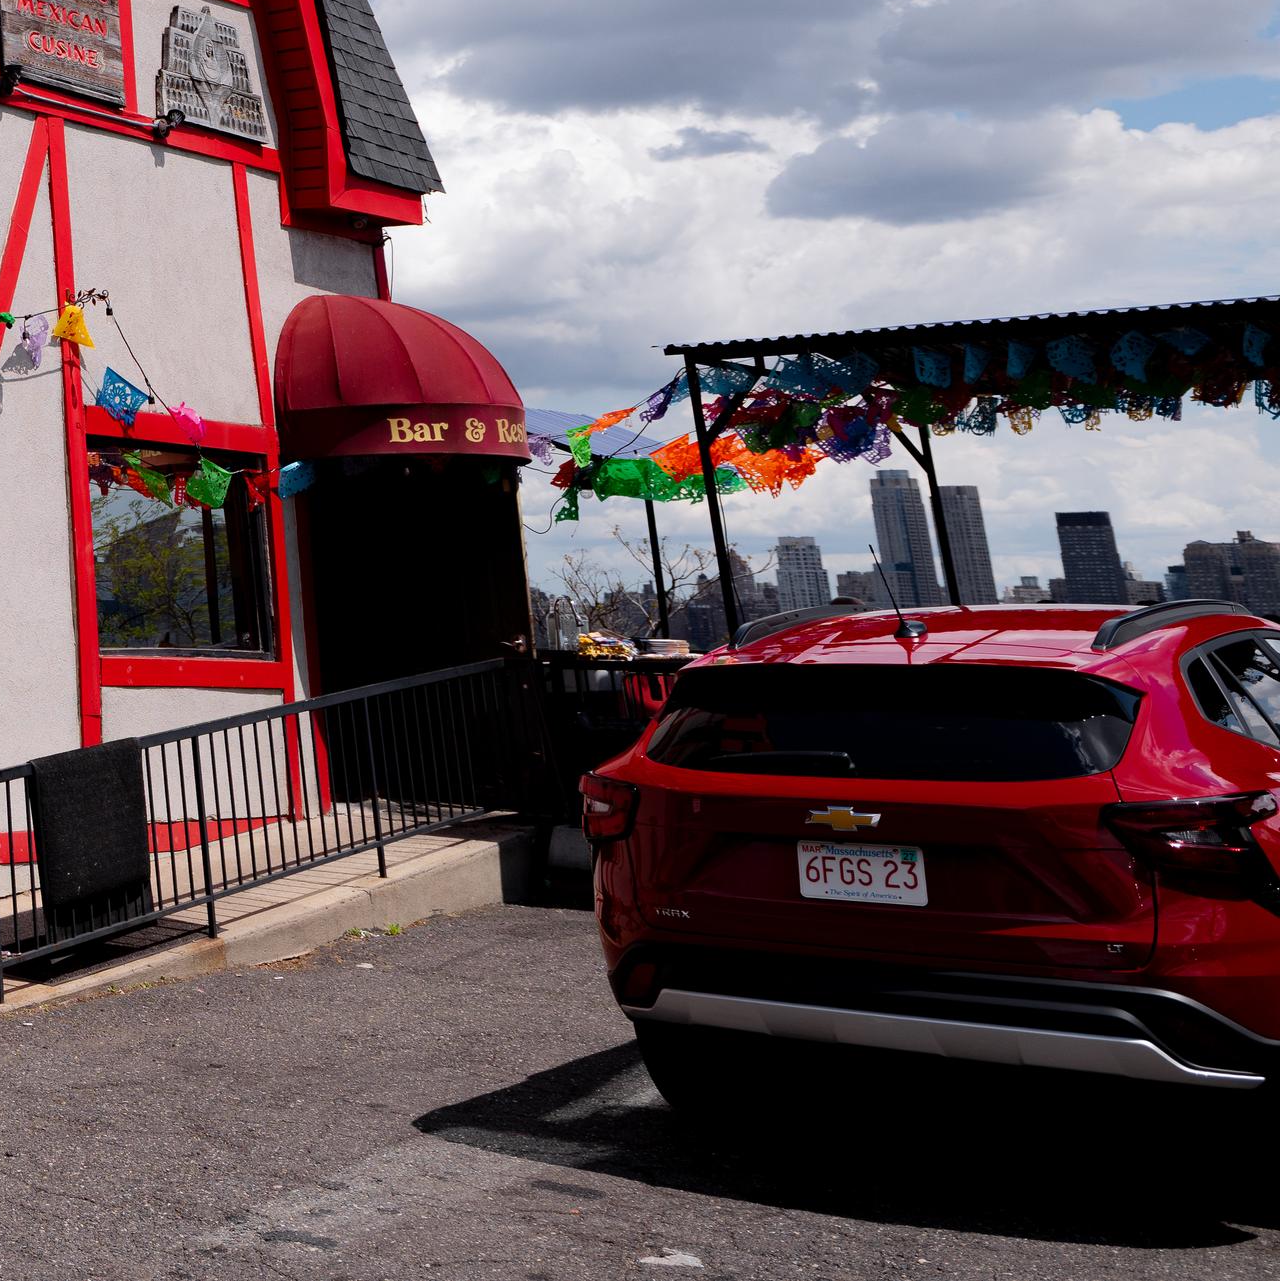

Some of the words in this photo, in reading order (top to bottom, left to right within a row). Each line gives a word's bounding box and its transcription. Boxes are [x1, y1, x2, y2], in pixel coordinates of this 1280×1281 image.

[28, 31, 100, 68] CUSINE
[387, 418, 448, 442] Bar
[465, 418, 486, 442] &
[802, 845, 821, 853] MAR
[825, 845, 894, 858] Massachusetts
[903, 852, 914, 861] 27
[806, 856, 872, 886] 6FGS
[883, 860, 918, 889] 23
